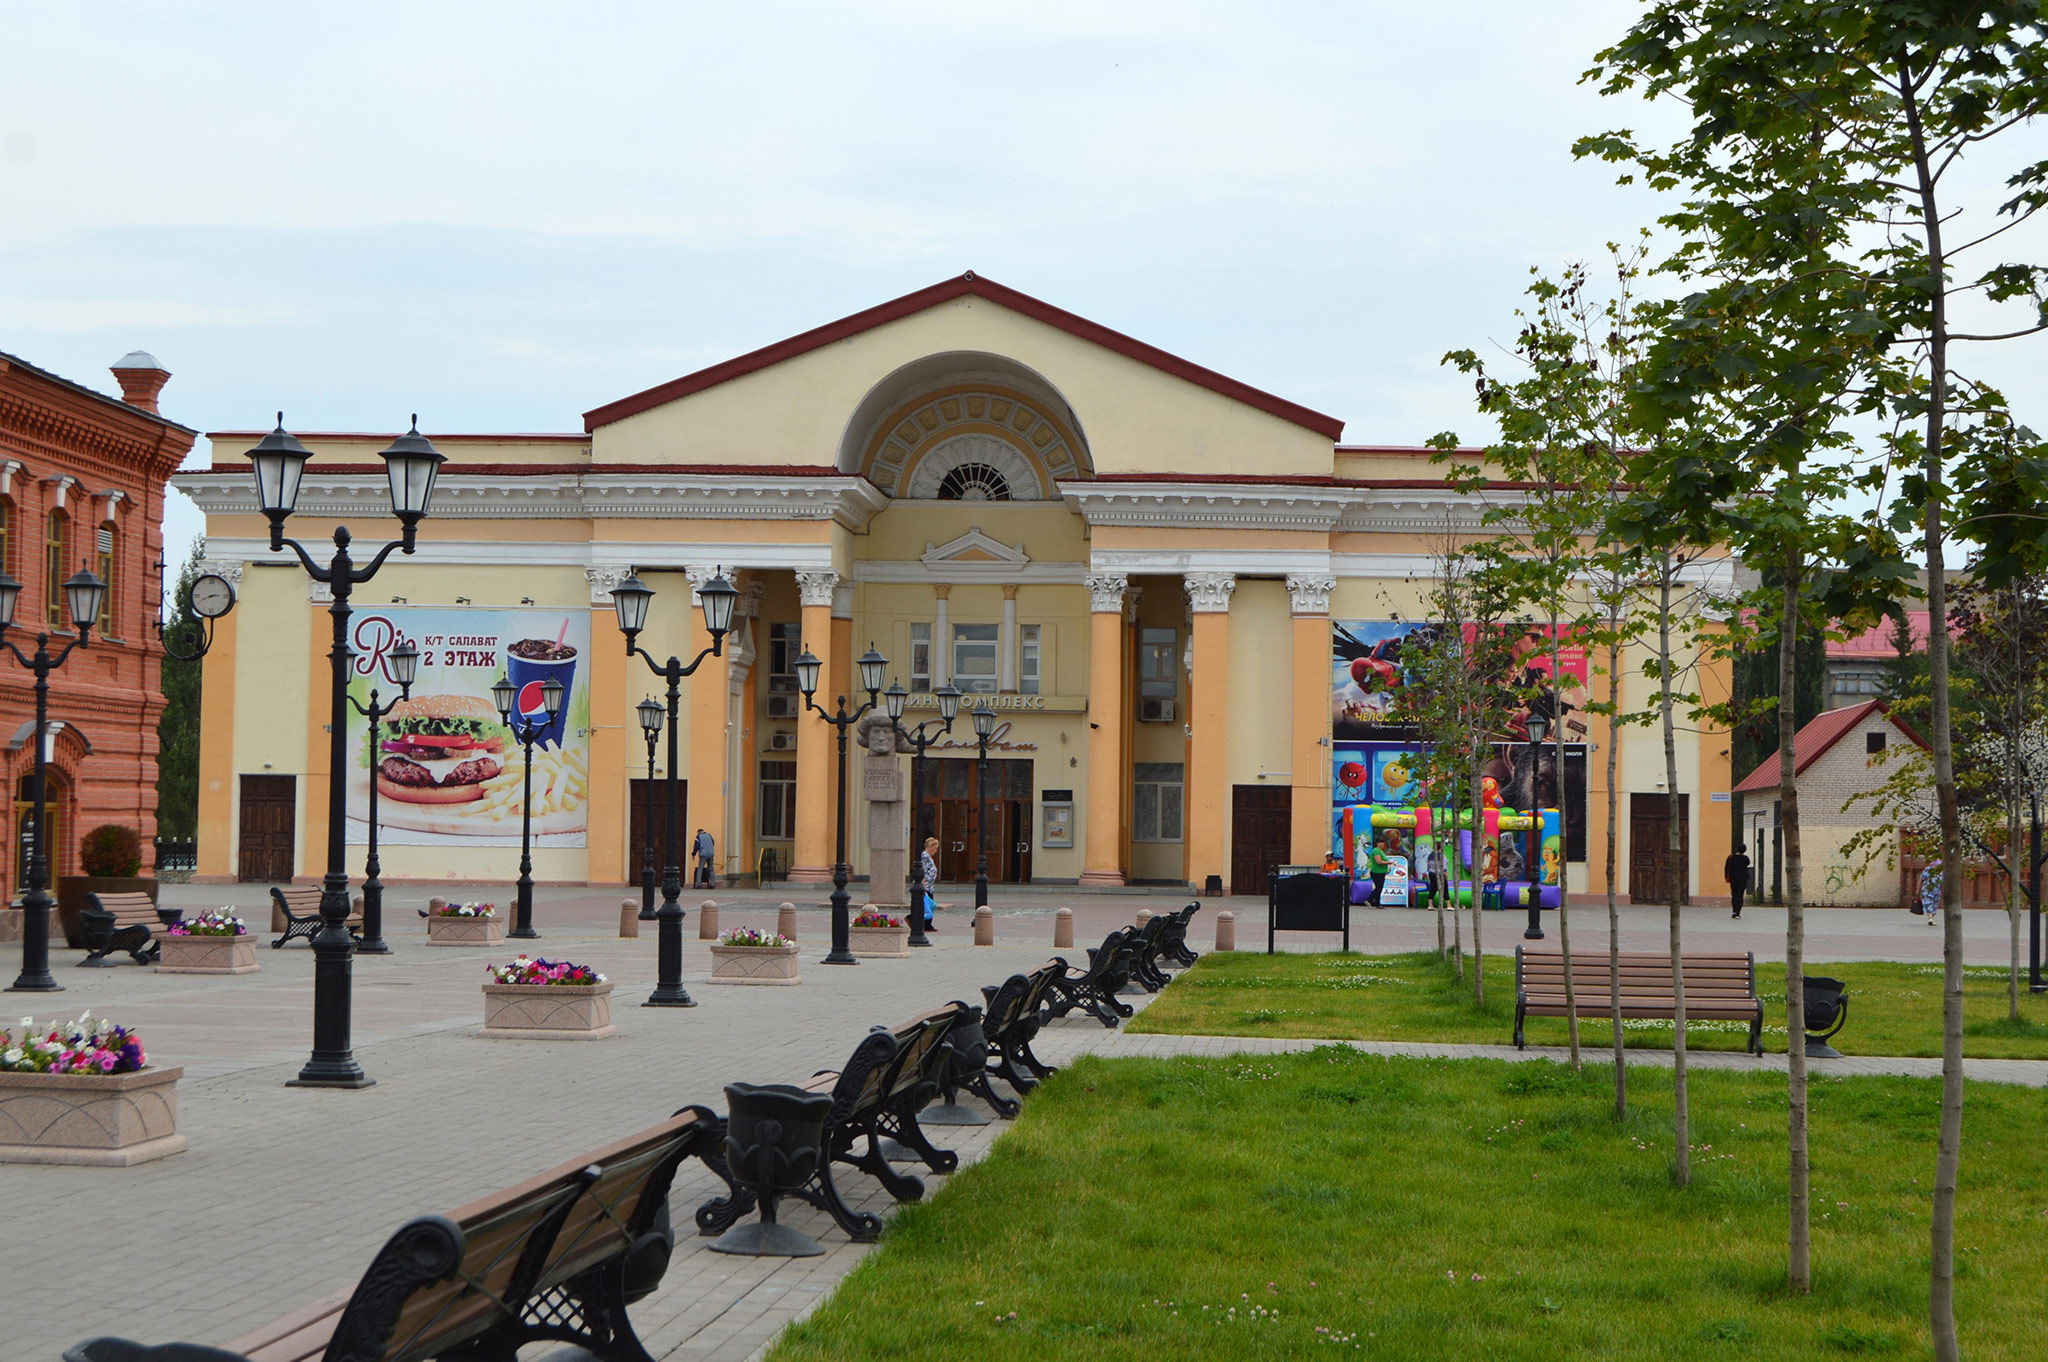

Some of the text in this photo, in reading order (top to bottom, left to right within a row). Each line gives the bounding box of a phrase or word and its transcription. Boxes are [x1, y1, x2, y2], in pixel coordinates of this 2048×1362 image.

[425, 636, 498, 646] К/Т САЛАВАТ
[424, 651, 496, 667] 2 ЭТАЖ
[898, 696, 1044, 708] ИНОМПЛЕКС
